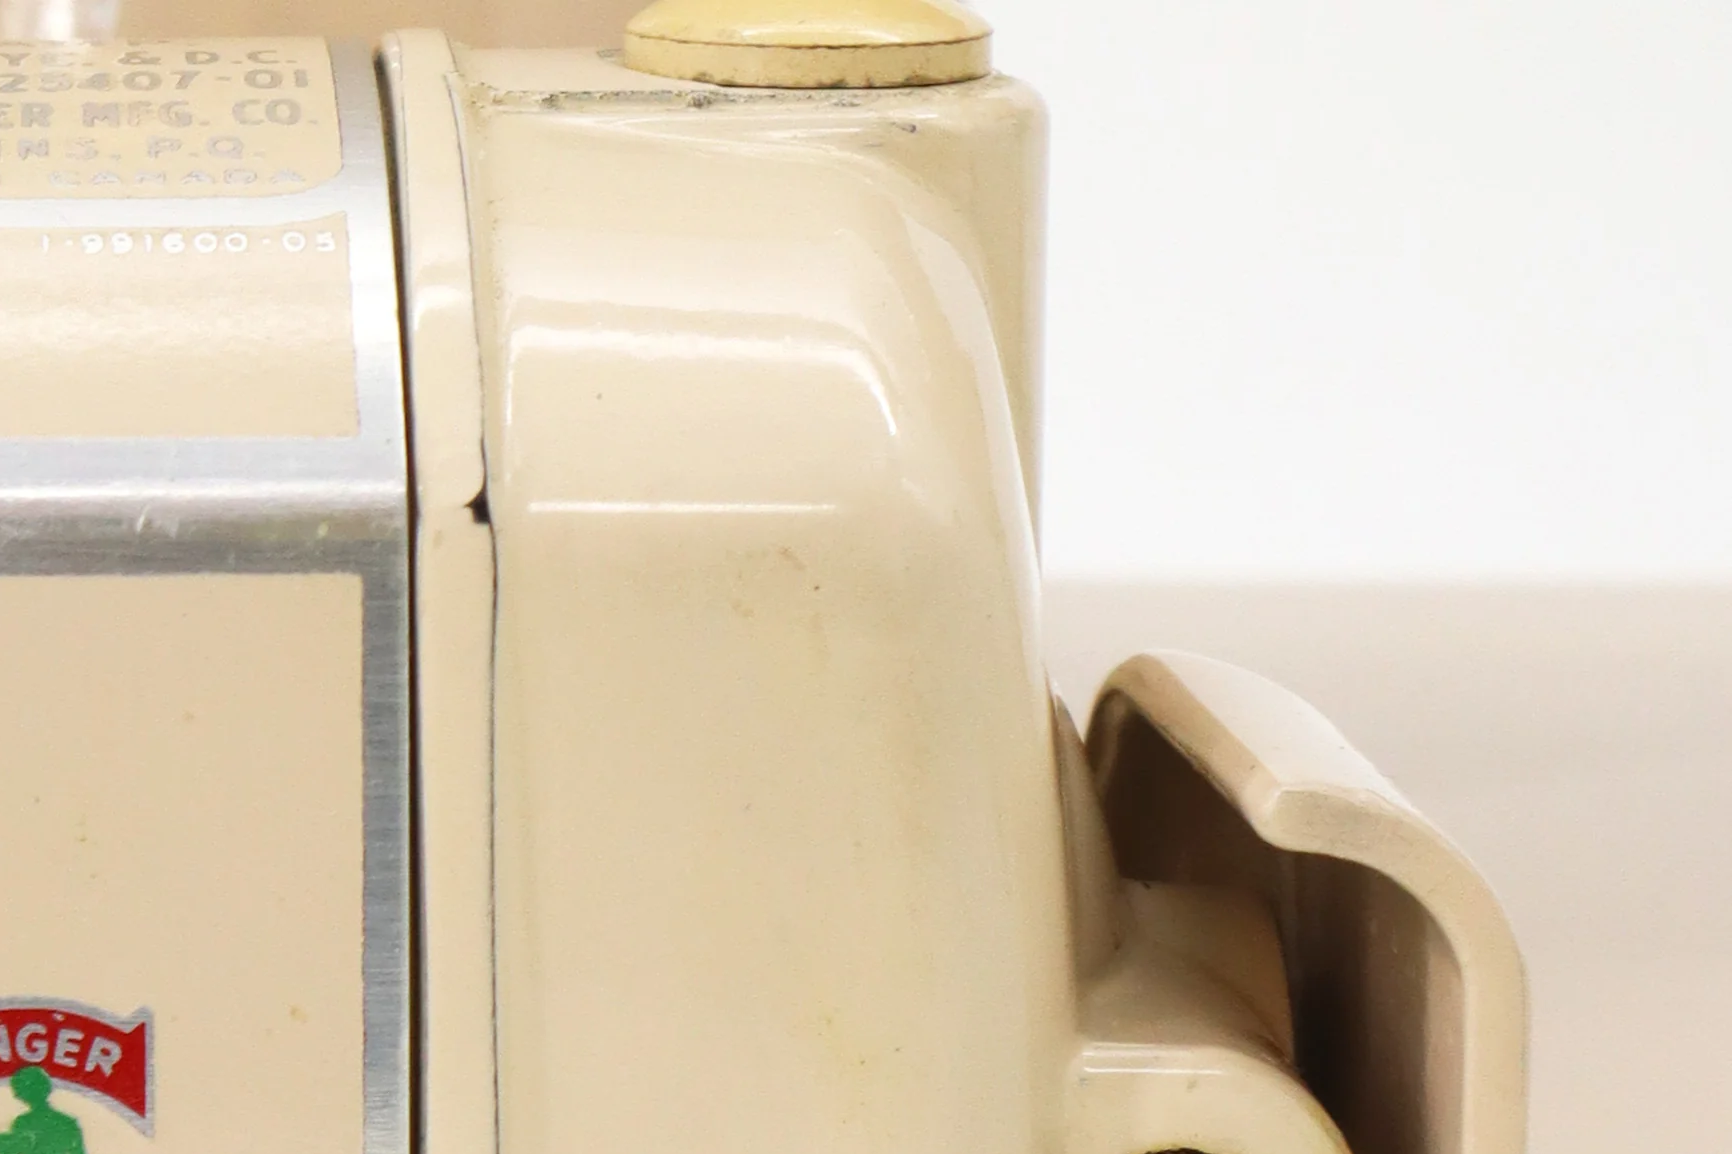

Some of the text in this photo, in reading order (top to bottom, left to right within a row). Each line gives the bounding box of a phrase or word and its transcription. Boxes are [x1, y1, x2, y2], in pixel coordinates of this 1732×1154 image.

[117, 50, 162, 65] &
[184, 49, 298, 65] D.C.
[80, 100, 211, 128] MFG.
[231, 98, 319, 126] CO.
[146, 135, 267, 160] P.Q.
[48, 168, 307, 188] CANADA
